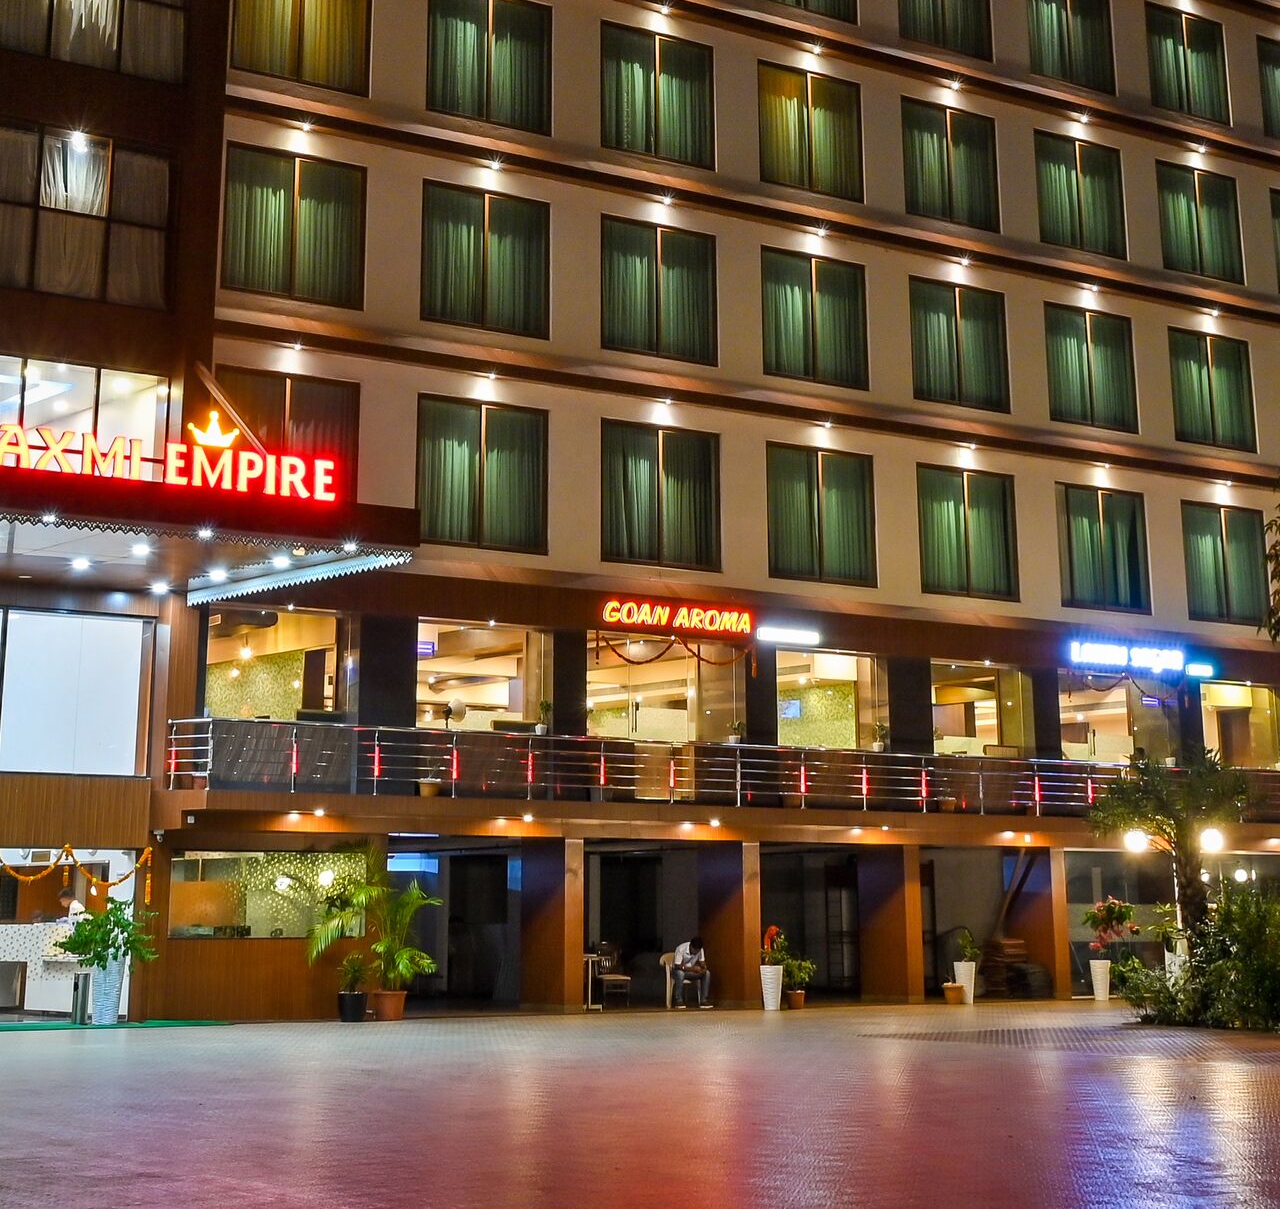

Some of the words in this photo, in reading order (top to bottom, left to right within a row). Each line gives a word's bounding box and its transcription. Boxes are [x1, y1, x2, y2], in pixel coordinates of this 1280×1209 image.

[165, 442, 336, 502] EMPIRE
[603, 600, 670, 626] GOAN
[673, 607, 751, 633] AROMA
